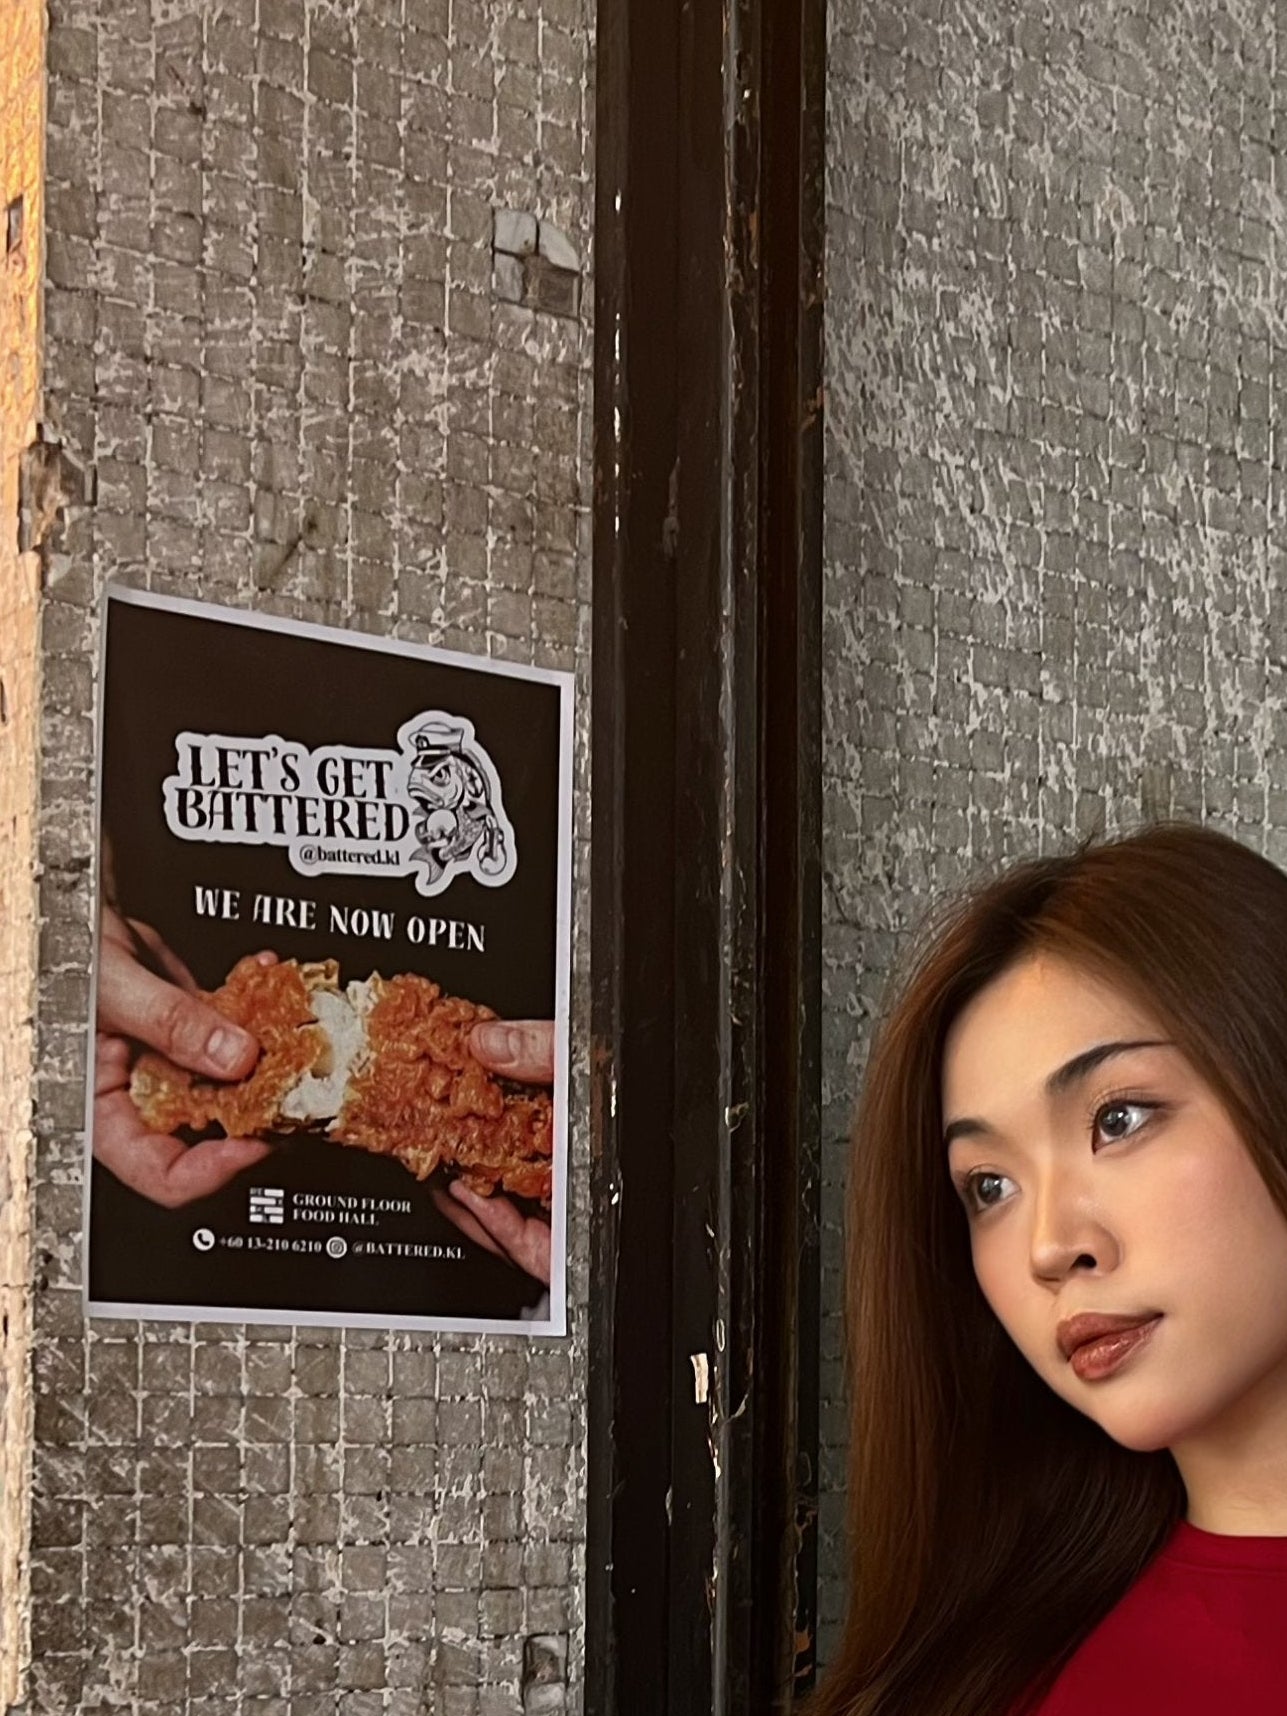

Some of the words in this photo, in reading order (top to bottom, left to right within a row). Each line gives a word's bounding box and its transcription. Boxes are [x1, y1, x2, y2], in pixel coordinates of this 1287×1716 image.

[316, 756, 393, 800] GET
[175, 787, 410, 842] BATTERED
[299, 845, 401, 866] @battered.kl
[194, 886, 241, 920] WE
[252, 894, 317, 930] ARE
[329, 904, 395, 940] NOW
[407, 916, 486, 952] OPEN
[292, 1193, 358, 1209] GROUND
[361, 1199, 412, 1213] FLOOR
[293, 1208, 335, 1223] FOOD
[338, 1212, 379, 1226] HALL
[352, 1242, 465, 1260] @BATTERED.KL
